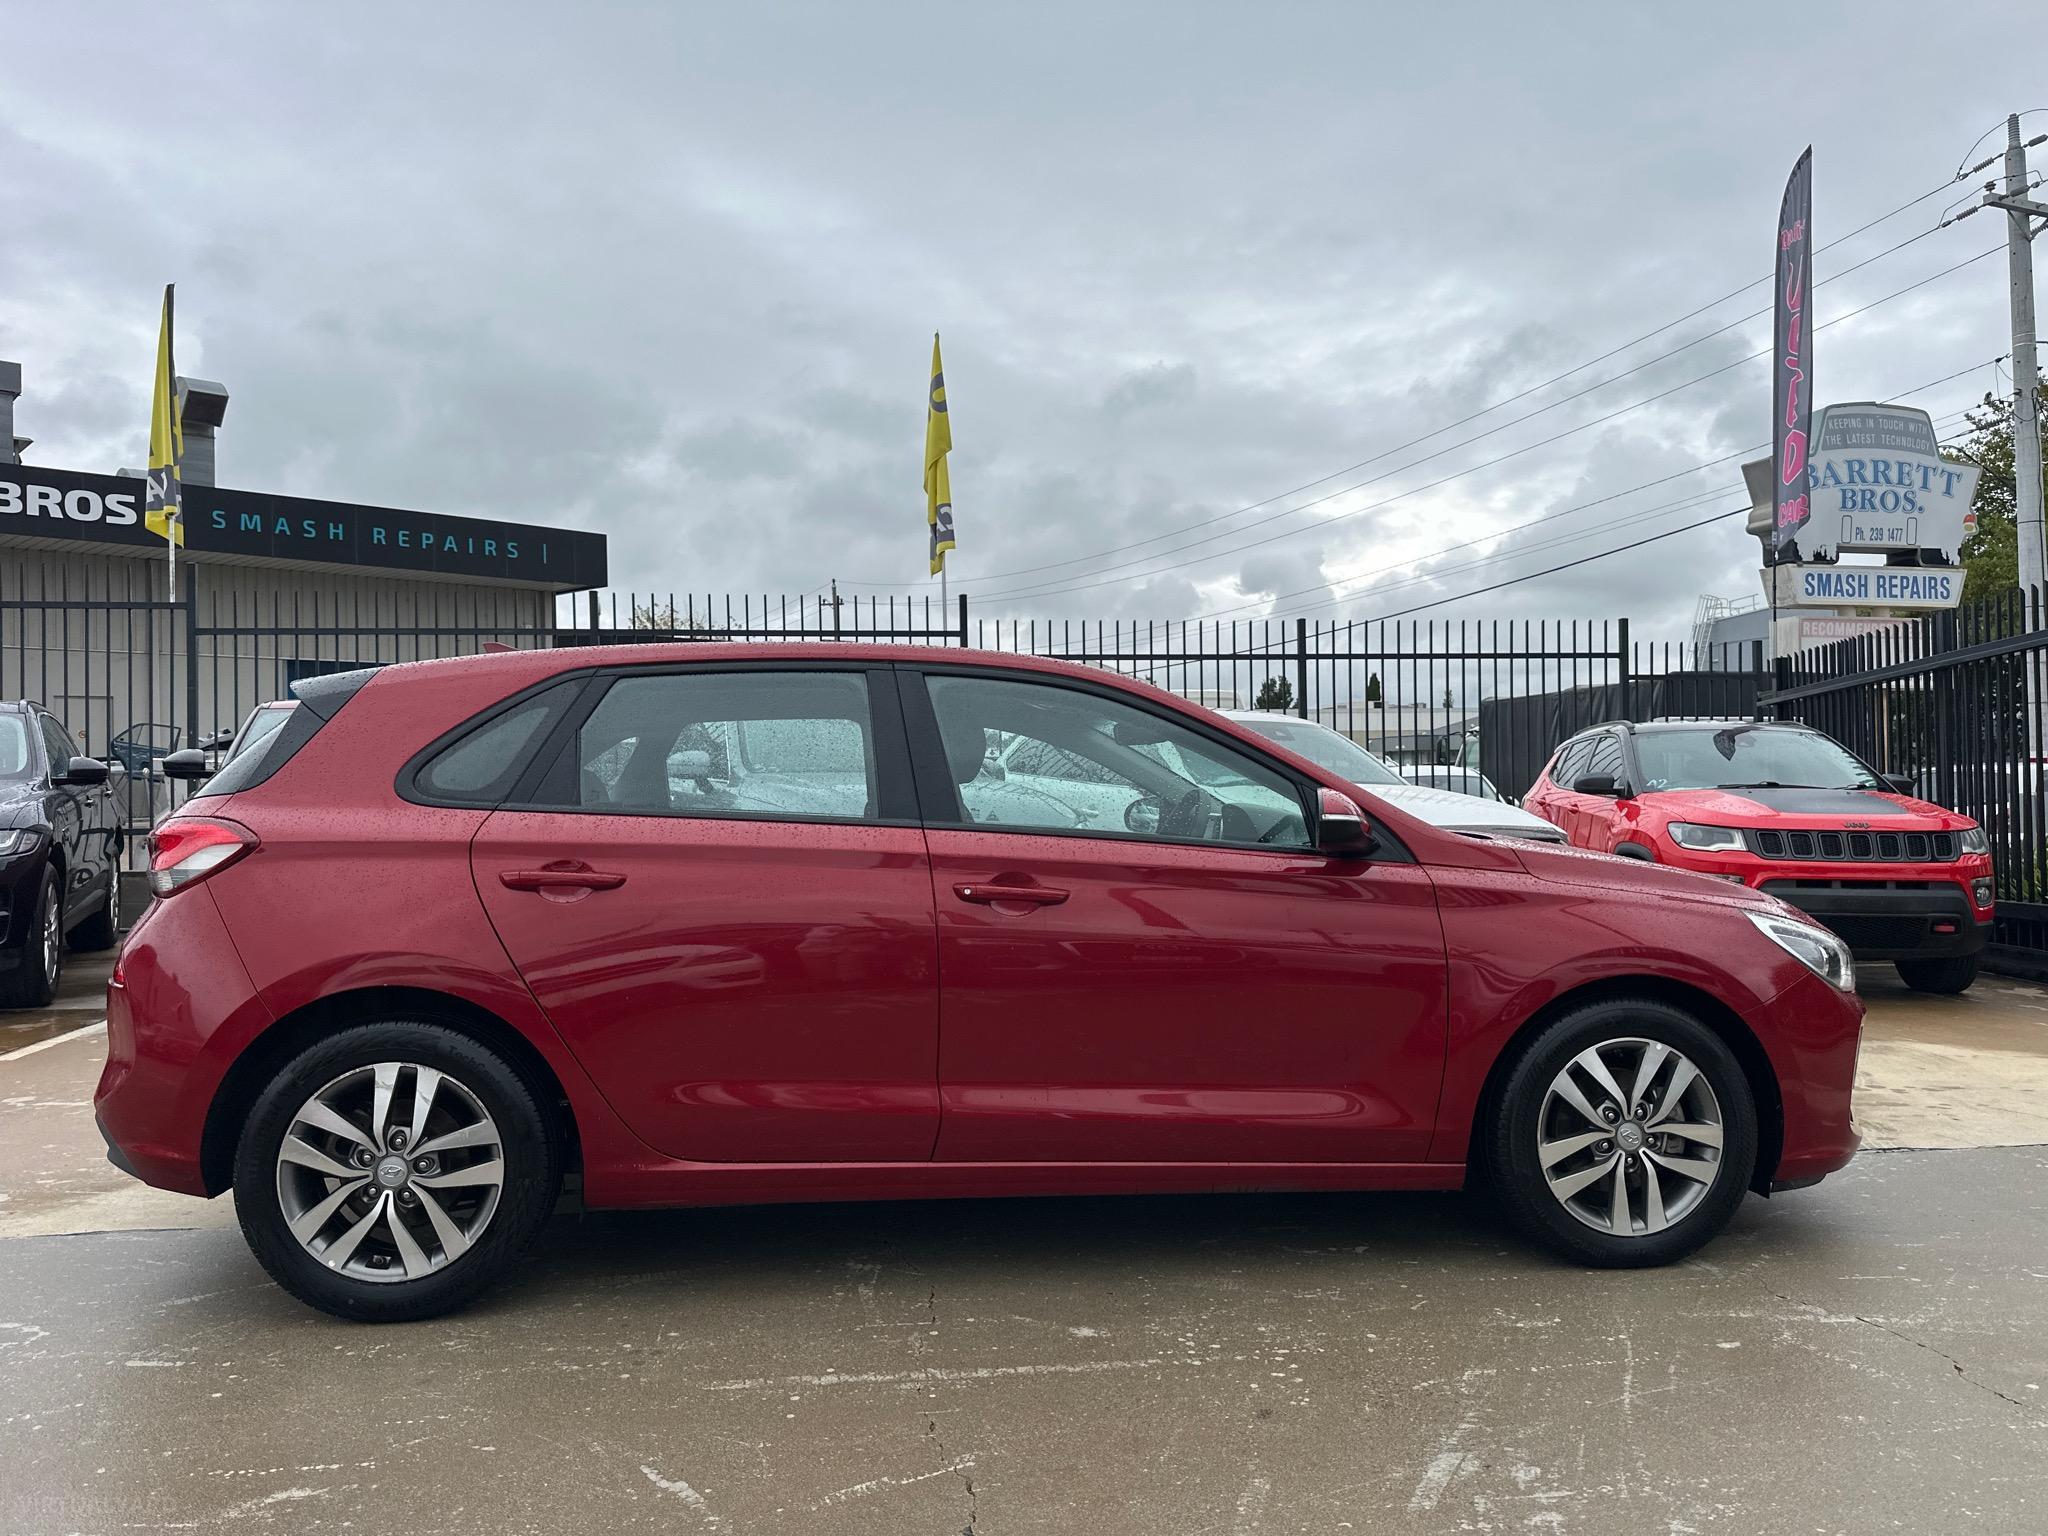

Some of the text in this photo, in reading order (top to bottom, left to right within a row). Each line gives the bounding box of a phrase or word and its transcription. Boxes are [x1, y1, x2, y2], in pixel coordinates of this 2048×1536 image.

[1828, 418, 1928, 434] KEEPING IN TOUCH WITH
[1825, 433, 1930, 451] THE LATEST TECHNOLOGY
[0, 481, 138, 525] BROS
[1840, 488, 1925, 514] BROS.
[211, 509, 519, 559] SMASH REPAIRS
[1855, 527, 1904, 541] Ph. 239 1477
[1804, 572, 1951, 600] SMASH REPAIRS
